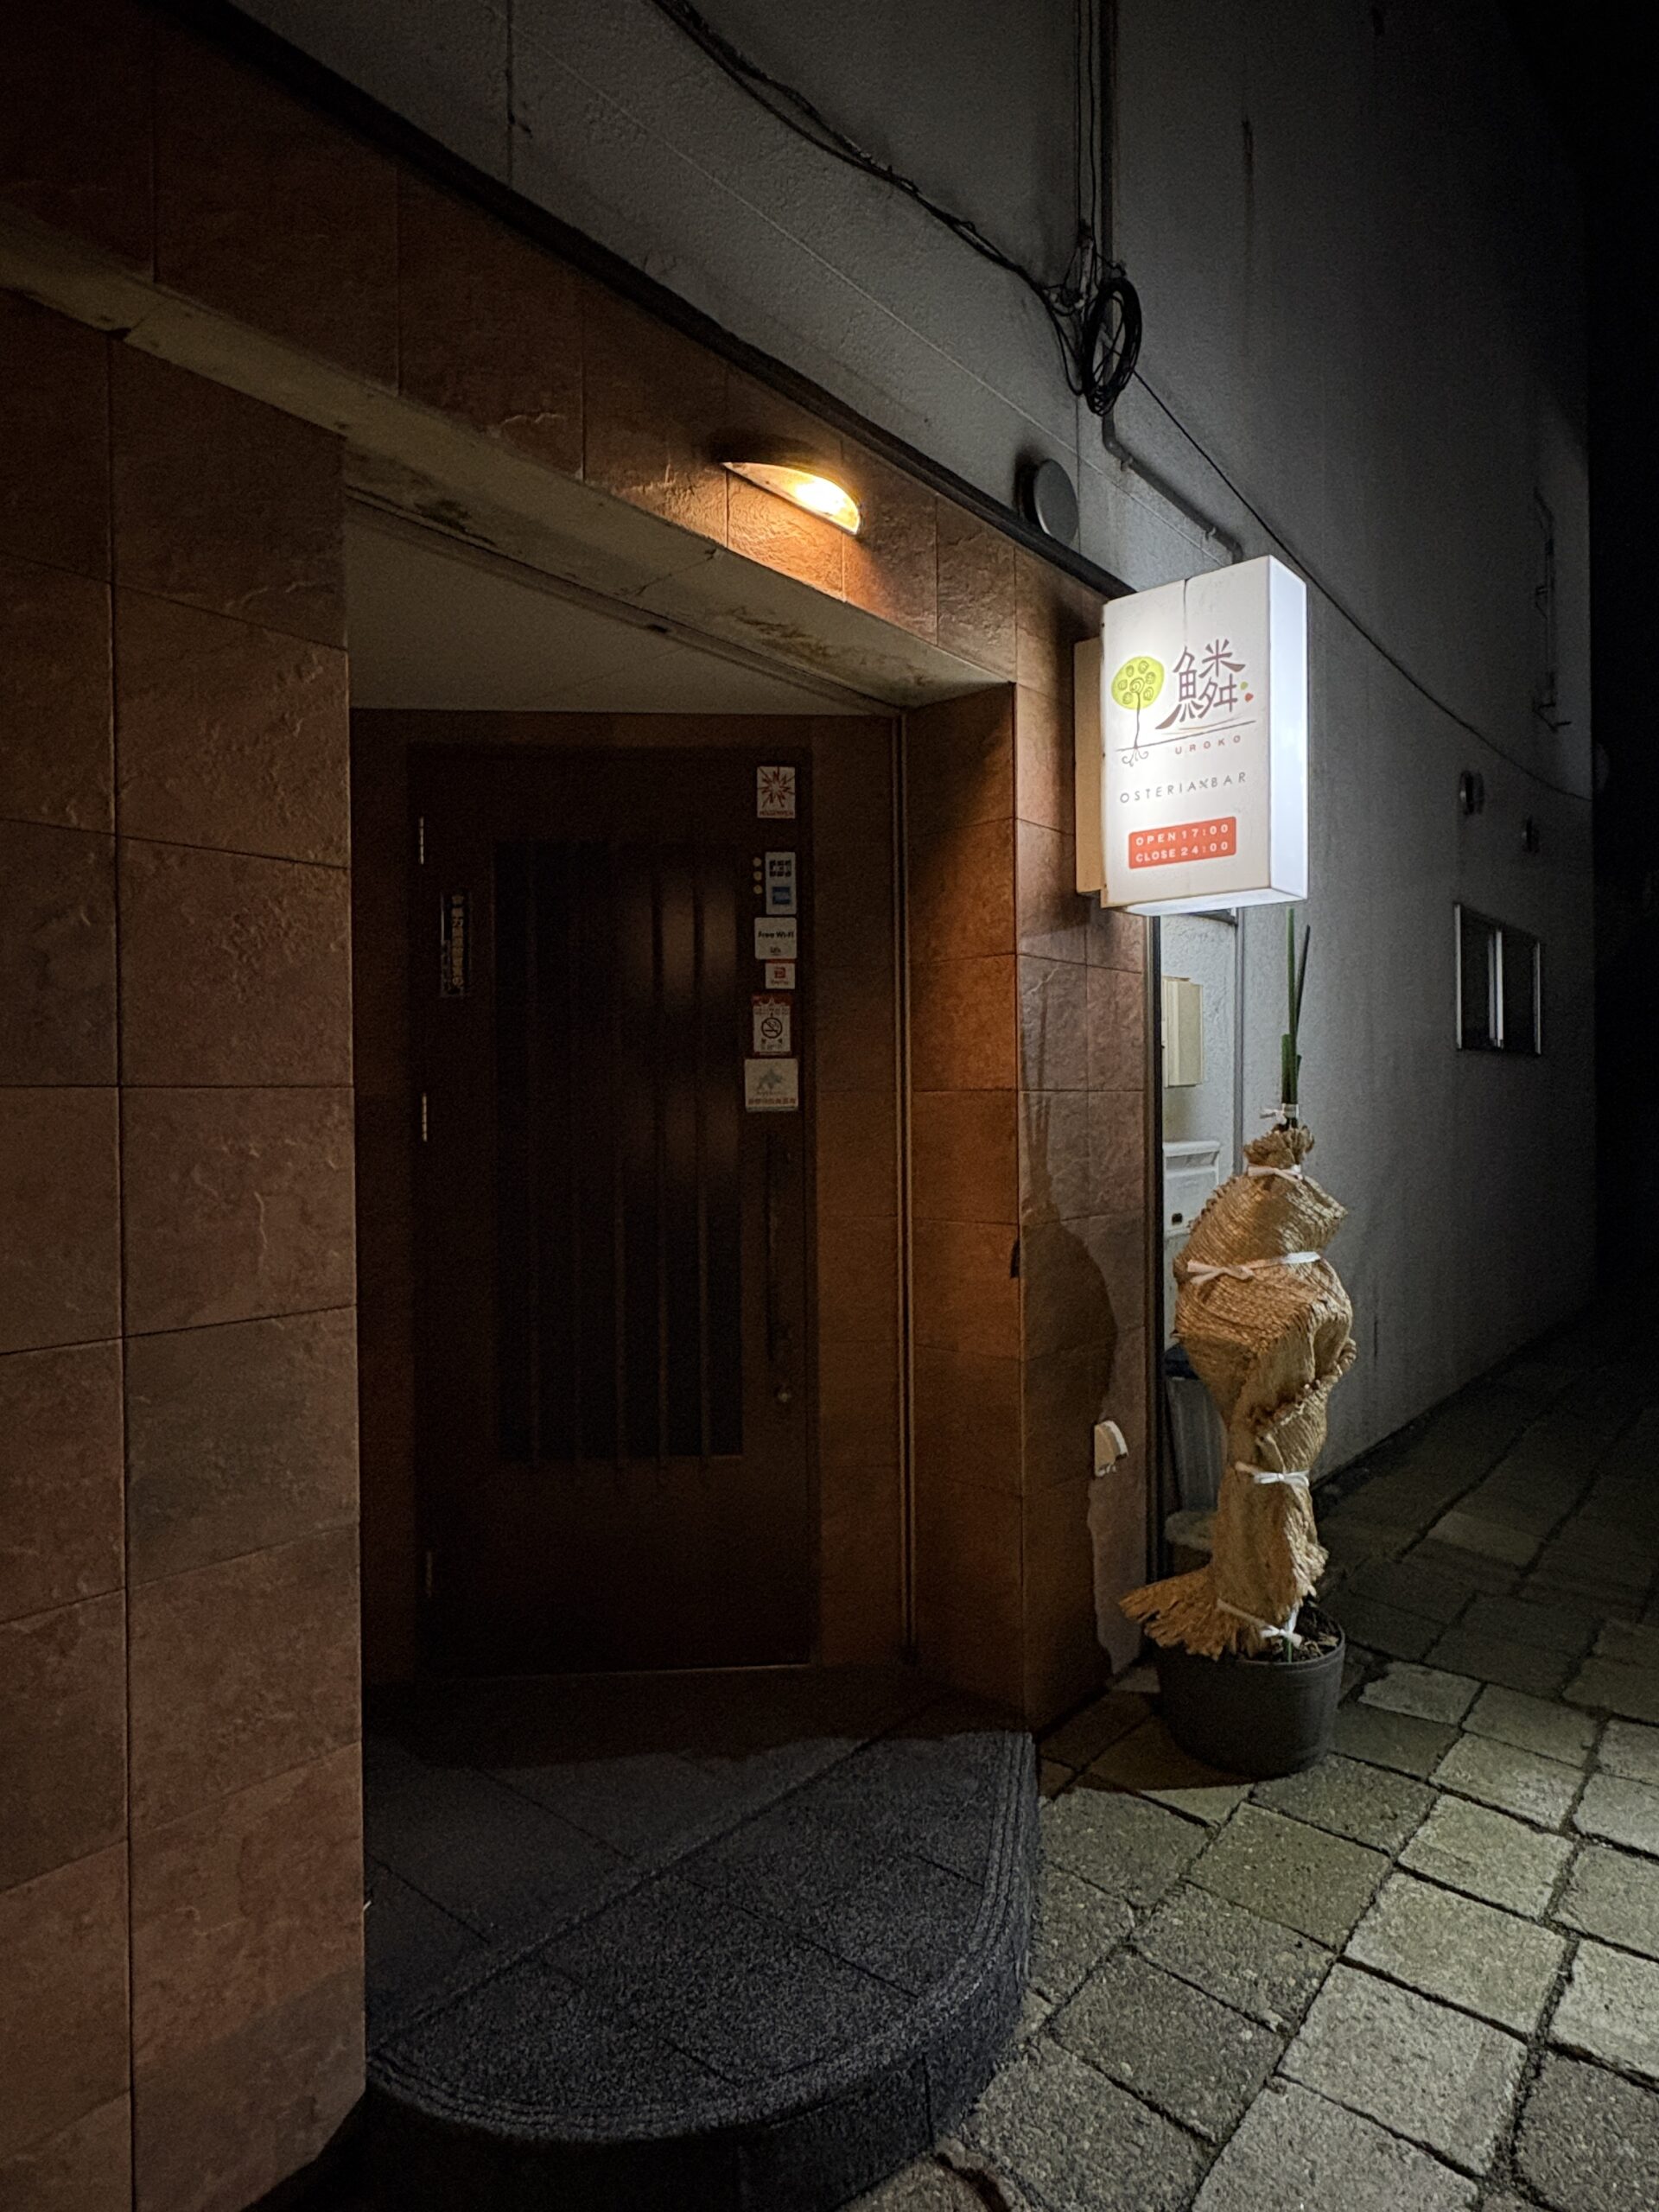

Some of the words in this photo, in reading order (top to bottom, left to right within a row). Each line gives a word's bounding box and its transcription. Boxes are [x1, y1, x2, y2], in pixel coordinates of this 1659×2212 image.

[1155, 639, 1245, 729] 鱗
[1175, 735, 1241, 754] UROKO
[1135, 831, 1176, 846] OPEN
[1181, 823, 1229, 839] 17:00
[1135, 849, 1176, 862] CLOSE
[1180, 841, 1229, 856] 24:00
